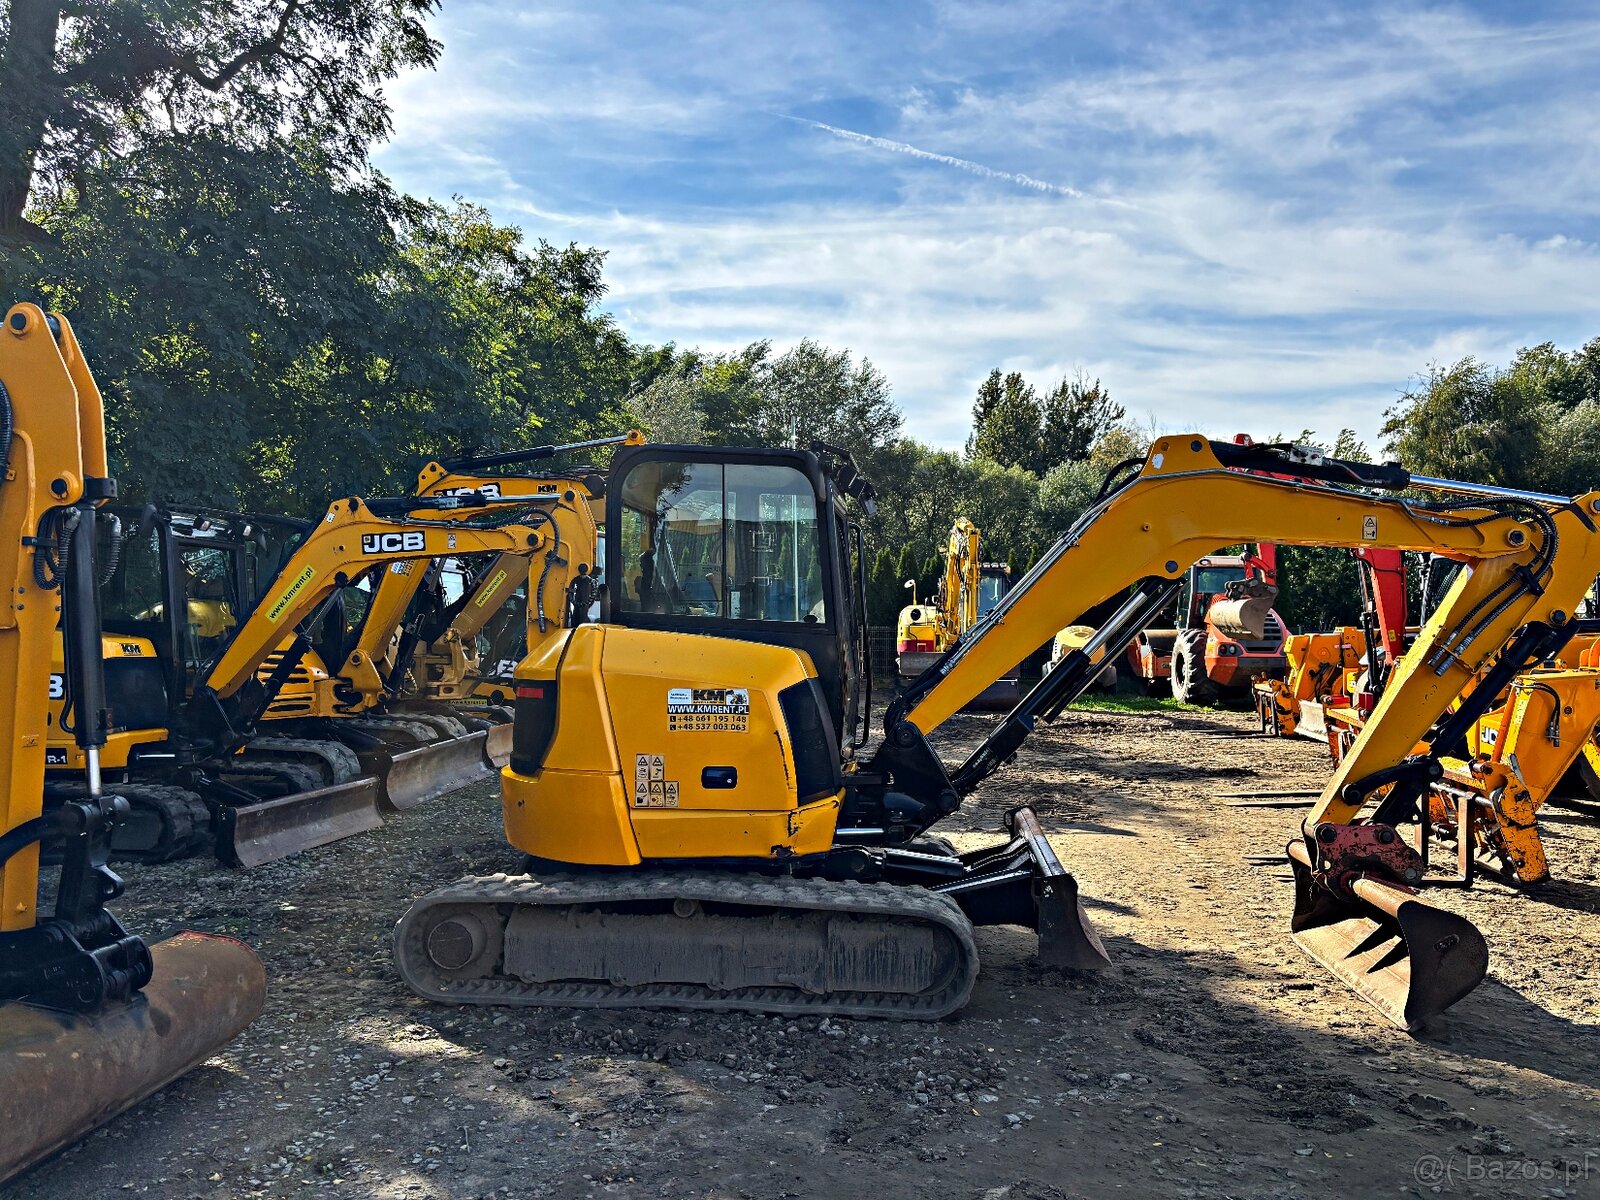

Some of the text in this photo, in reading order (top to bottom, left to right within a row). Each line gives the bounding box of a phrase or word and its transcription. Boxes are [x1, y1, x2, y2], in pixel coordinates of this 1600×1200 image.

[537, 485, 557, 493] KM
[363, 532, 425, 553] JCB
[269, 567, 313, 619] www.kmrent.pl
[692, 689, 724, 701] KM
[668, 704, 749, 714] WWW.KMRENT.PL
[713, 715, 729, 723] 195
[713, 723, 729, 731] 003
[1481, 727, 1499, 746] JC
